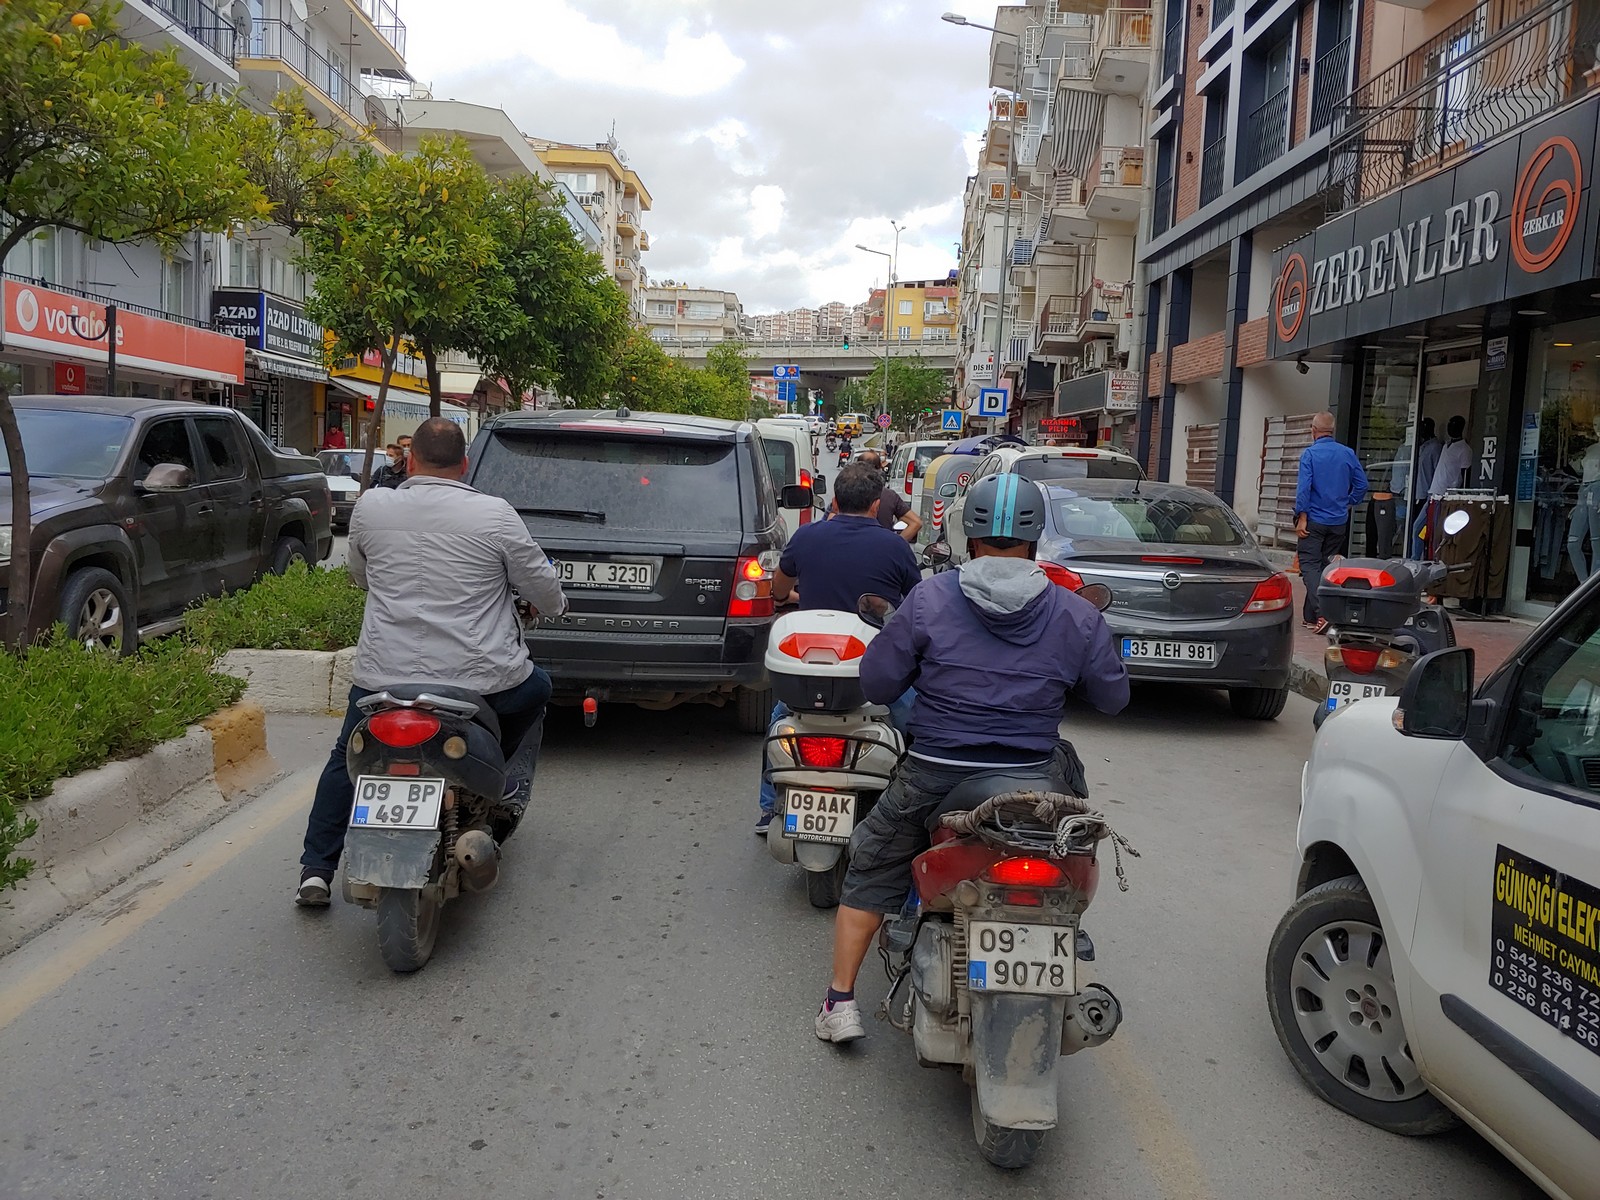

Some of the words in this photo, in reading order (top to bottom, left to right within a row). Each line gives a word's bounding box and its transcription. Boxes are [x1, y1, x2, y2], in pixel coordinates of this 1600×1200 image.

[1522, 209, 1564, 238] ZERKAR
[1310, 189, 1502, 316] ZERENLER
[219, 306, 257, 319] AZAD
[267, 307, 290, 332] AZAD
[44, 304, 124, 346] vodafoe
[988, 397, 999, 408] D
[587, 563, 596, 582] K
[607, 565, 648, 584] 3230
[605, 619, 680, 629] ROVER
[1131, 642, 1148, 656] 35
[1154, 643, 1180, 658] AEH
[1188, 644, 1213, 660] 981
[1332, 683, 1351, 696] 09
[1363, 685, 1383, 698] BV
[363, 782, 391, 801] 09
[407, 783, 436, 803] BP
[791, 793, 814, 811] 09
[817, 795, 851, 815] AAK
[376, 804, 419, 824] 497
[787, 824, 796, 832] TR
[803, 813, 838, 833] 607
[980, 928, 1014, 953] 09
[1053, 932, 1069, 957] K
[1514, 923, 1557, 962] MEHMET
[1559, 948, 1600, 987] CAYMA
[971, 978, 984, 988] TR
[994, 960, 1065, 988] 9078
[1496, 938, 1505, 952] 0
[1509, 945, 1538, 973] 542
[1542, 965, 1573, 992] 236
[1578, 984, 1600, 1010] 72
[1496, 955, 1505, 970] 0
[1509, 963, 1537, 989] 530
[1542, 982, 1573, 1010] 874
[1577, 1004, 1600, 1029] 22
[1494, 972, 1503, 986] 0
[1507, 980, 1536, 1007] 256
[1540, 1001, 1571, 1030] 614
[1576, 1022, 1599, 1047] 56
